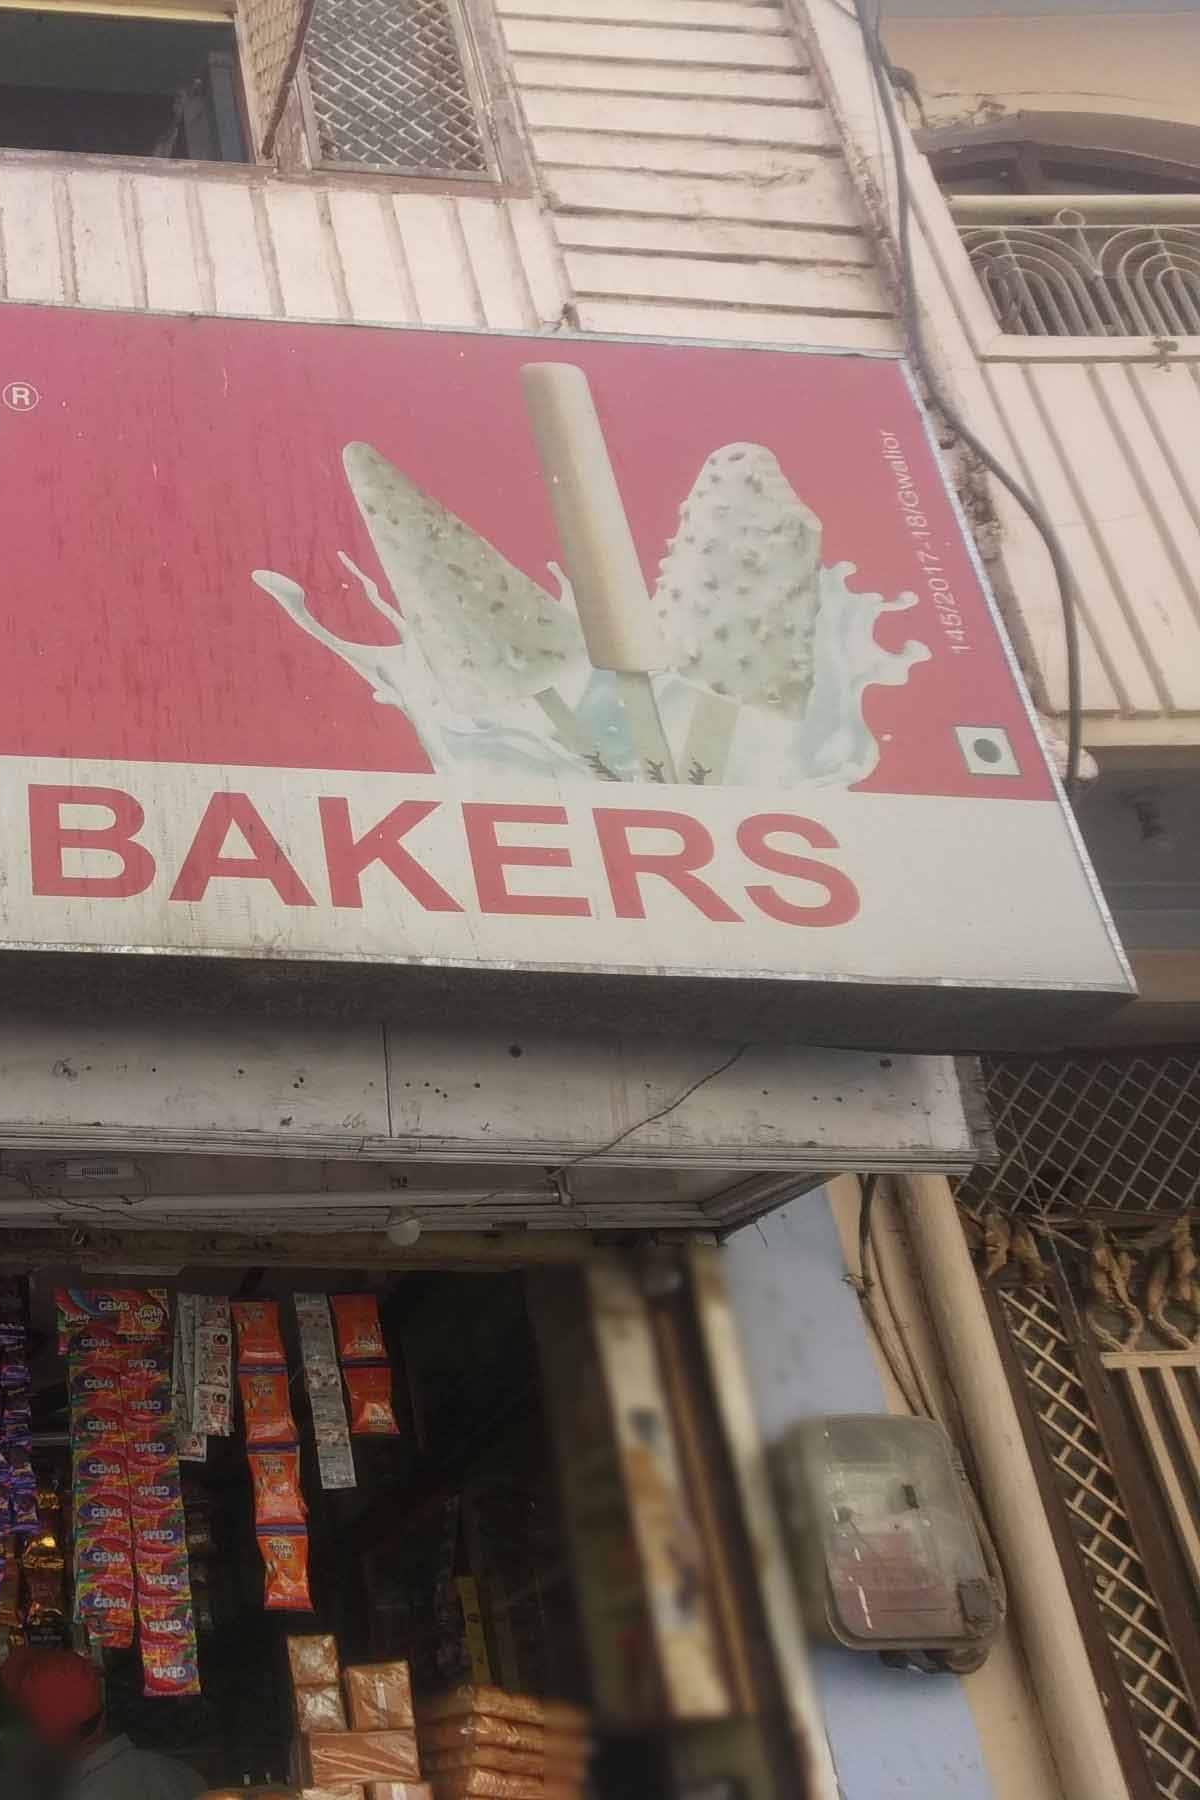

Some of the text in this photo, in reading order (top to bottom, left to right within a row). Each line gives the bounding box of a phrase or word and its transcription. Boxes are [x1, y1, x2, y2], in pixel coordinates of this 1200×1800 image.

[26, 783, 862, 929] BAKERS
[98, 1301, 131, 1313] GEMS
[84, 1378, 114, 1389] GEMS
[87, 1420, 118, 1431] GEMS
[135, 1442, 166, 1453] GEMS
[88, 1463, 121, 1474] GEMS
[137, 1486, 170, 1496] GEMS
[91, 1507, 122, 1518] GEMS
[143, 1530, 174, 1541] GEMS
[92, 1551, 125, 1562] GEMS
[146, 1574, 178, 1585] GEMS
[94, 1597, 128, 1609] GEMS
[148, 1620, 182, 1632] GEMS
[152, 1667, 187, 1679] GEMS
